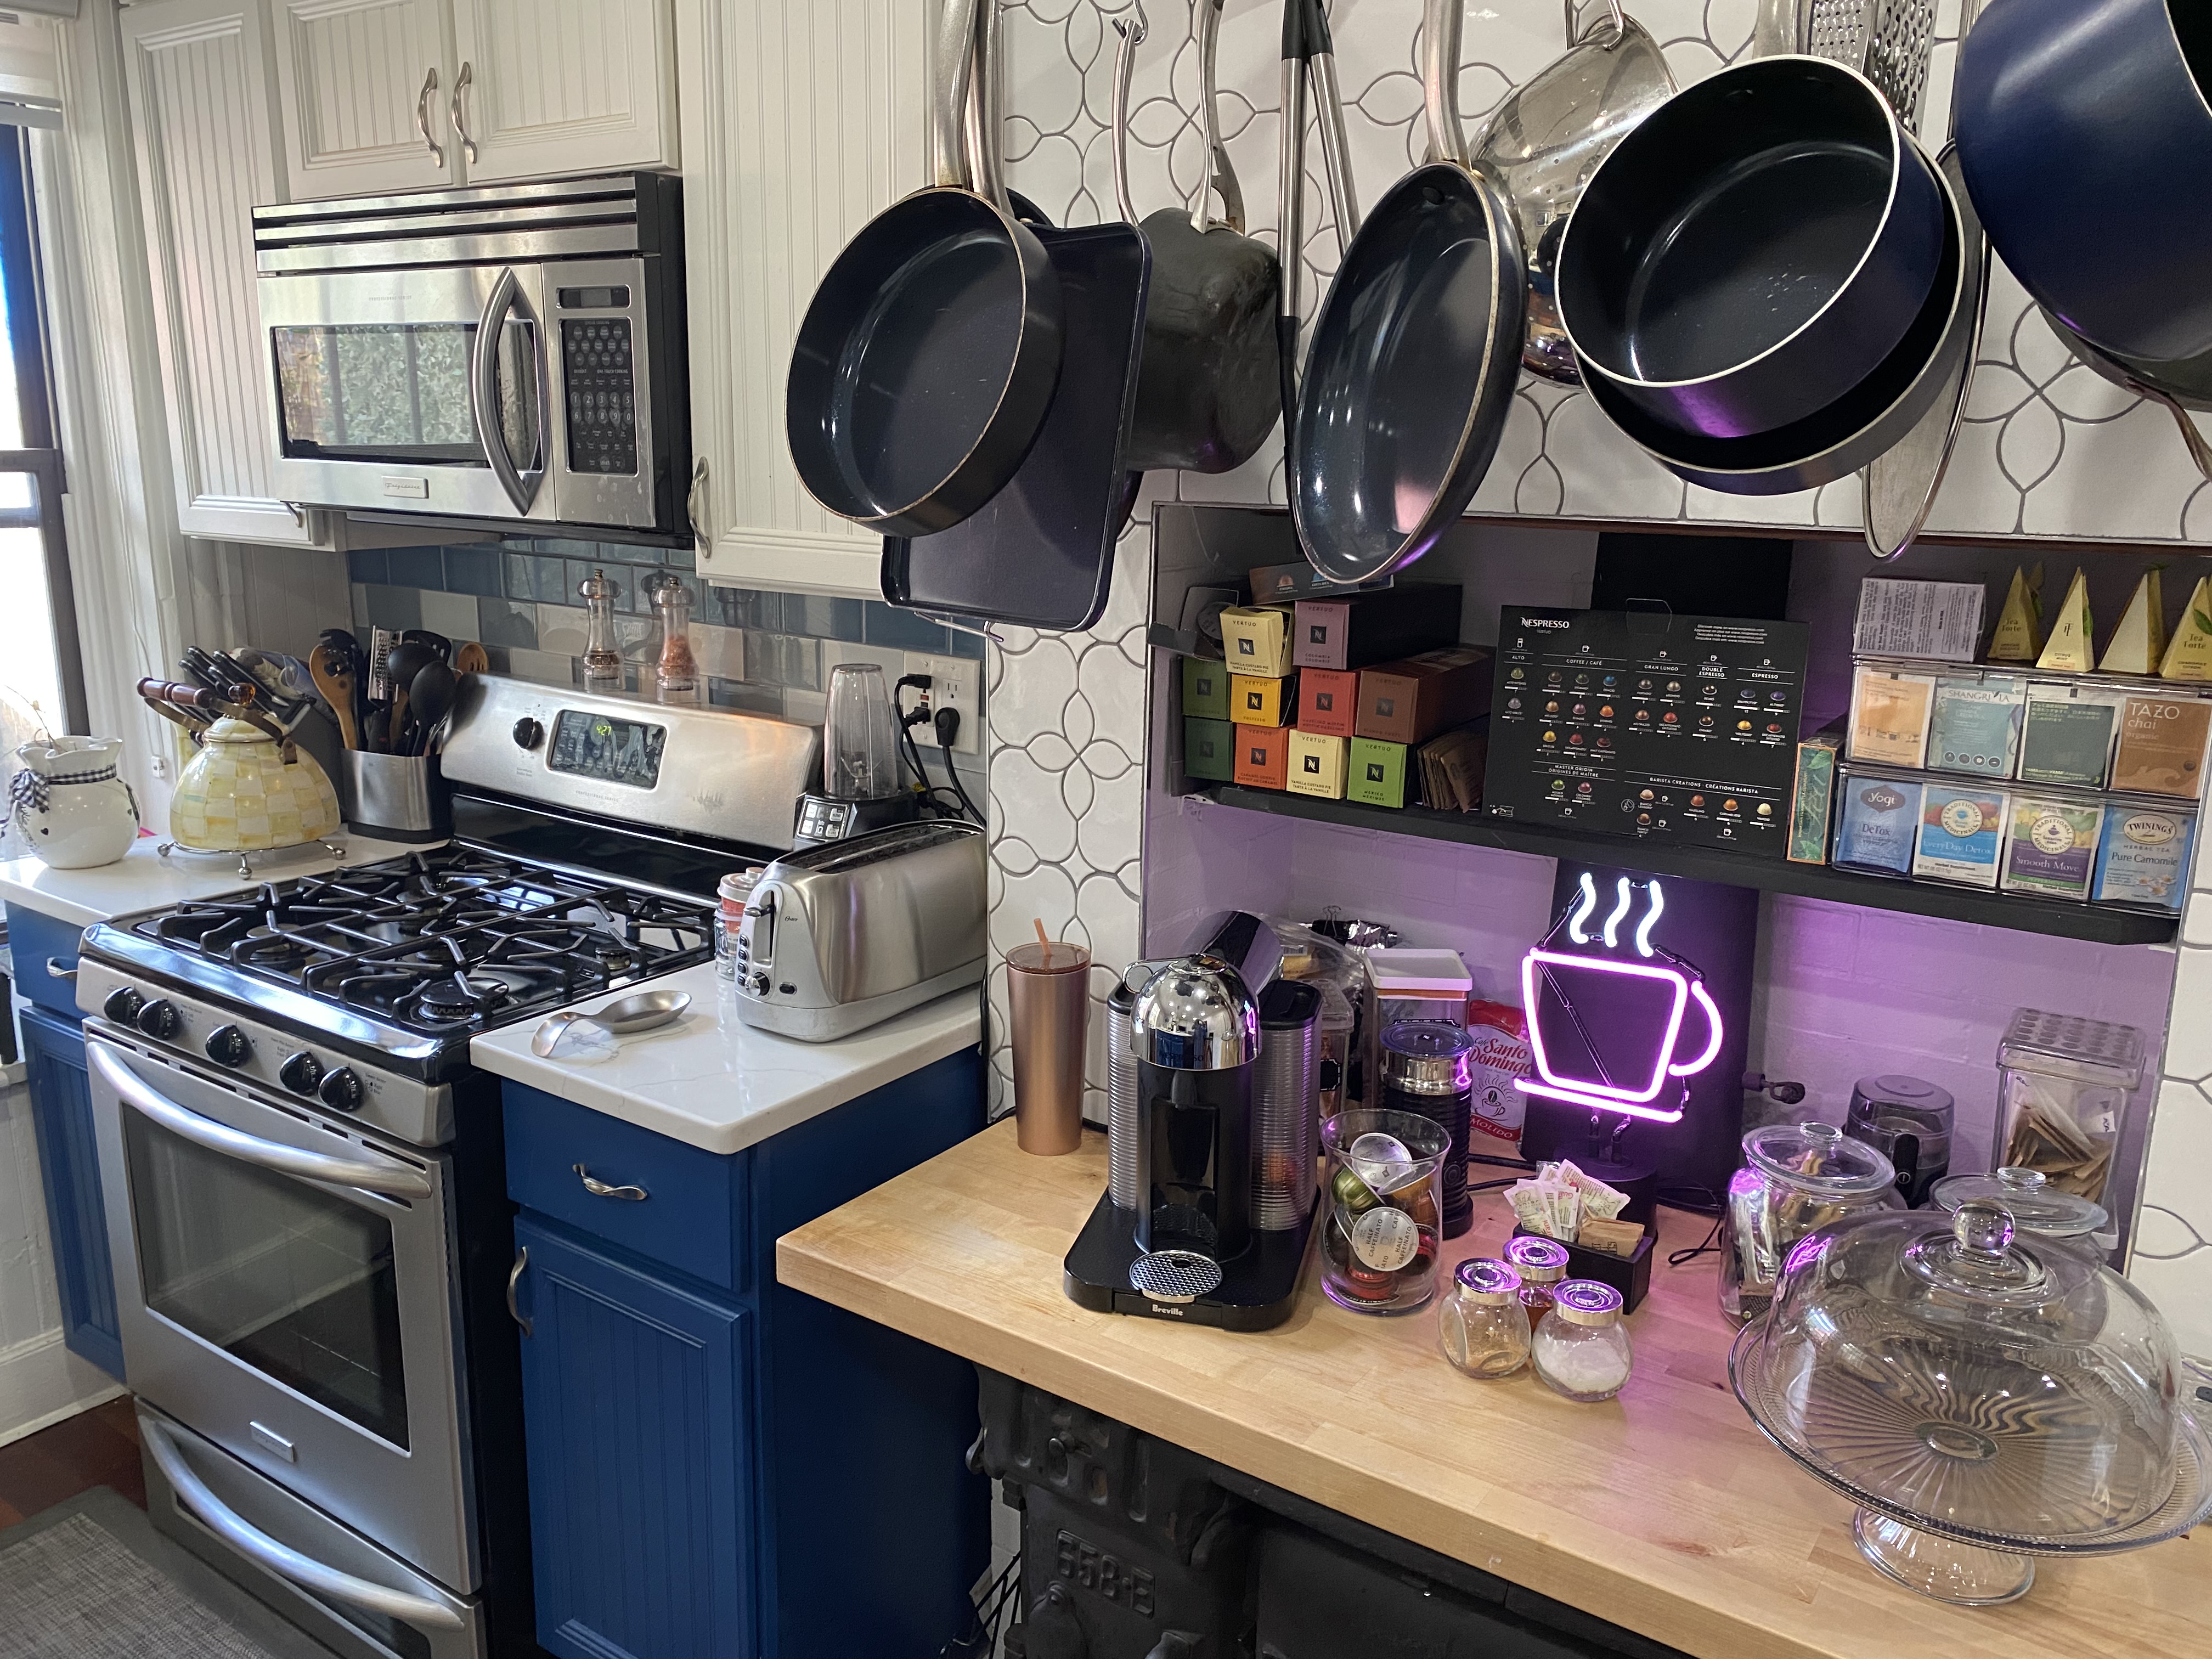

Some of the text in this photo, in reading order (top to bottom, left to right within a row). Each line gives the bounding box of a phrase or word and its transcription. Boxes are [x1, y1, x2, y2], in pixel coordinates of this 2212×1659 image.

[1521, 617, 1570, 629] NESPRESSO
[1948, 690, 1991, 702] SHANGRI
[2130, 702, 2180, 720] TAZO
[2128, 716, 2157, 730] chai
[1302, 736, 1326, 744] VERTUO
[2125, 731, 2159, 740] organic
[1672, 779, 1701, 788] CREATIONS
[1705, 783, 1735, 792] CRÉATIONS
[1944, 802, 1980, 819] TRADITIONAL
[1862, 823, 1891, 836] DeTox
[1944, 820, 1980, 835] MEDICINALS
[2034, 818, 2072, 835] TRADITIONAL
[2034, 837, 2072, 852] MEDICINALS
[2016, 855, 2079, 872] Smooth Move
[2111, 852, 2178, 866] Pure Camomile
[1483, 1038, 1528, 1059] Santo
[1469, 1045, 1532, 1079] Domingo
[1470, 1118, 1513, 1138] MOLIDO
[1365, 1228, 1374, 1245] HALF
[1368, 1218, 1383, 1257] CAFFEINATO
[1395, 1236, 1403, 1252] HALF
[1397, 1226, 1412, 1265] CAFFEINATO
[1152, 1304, 1183, 1316] Breville
